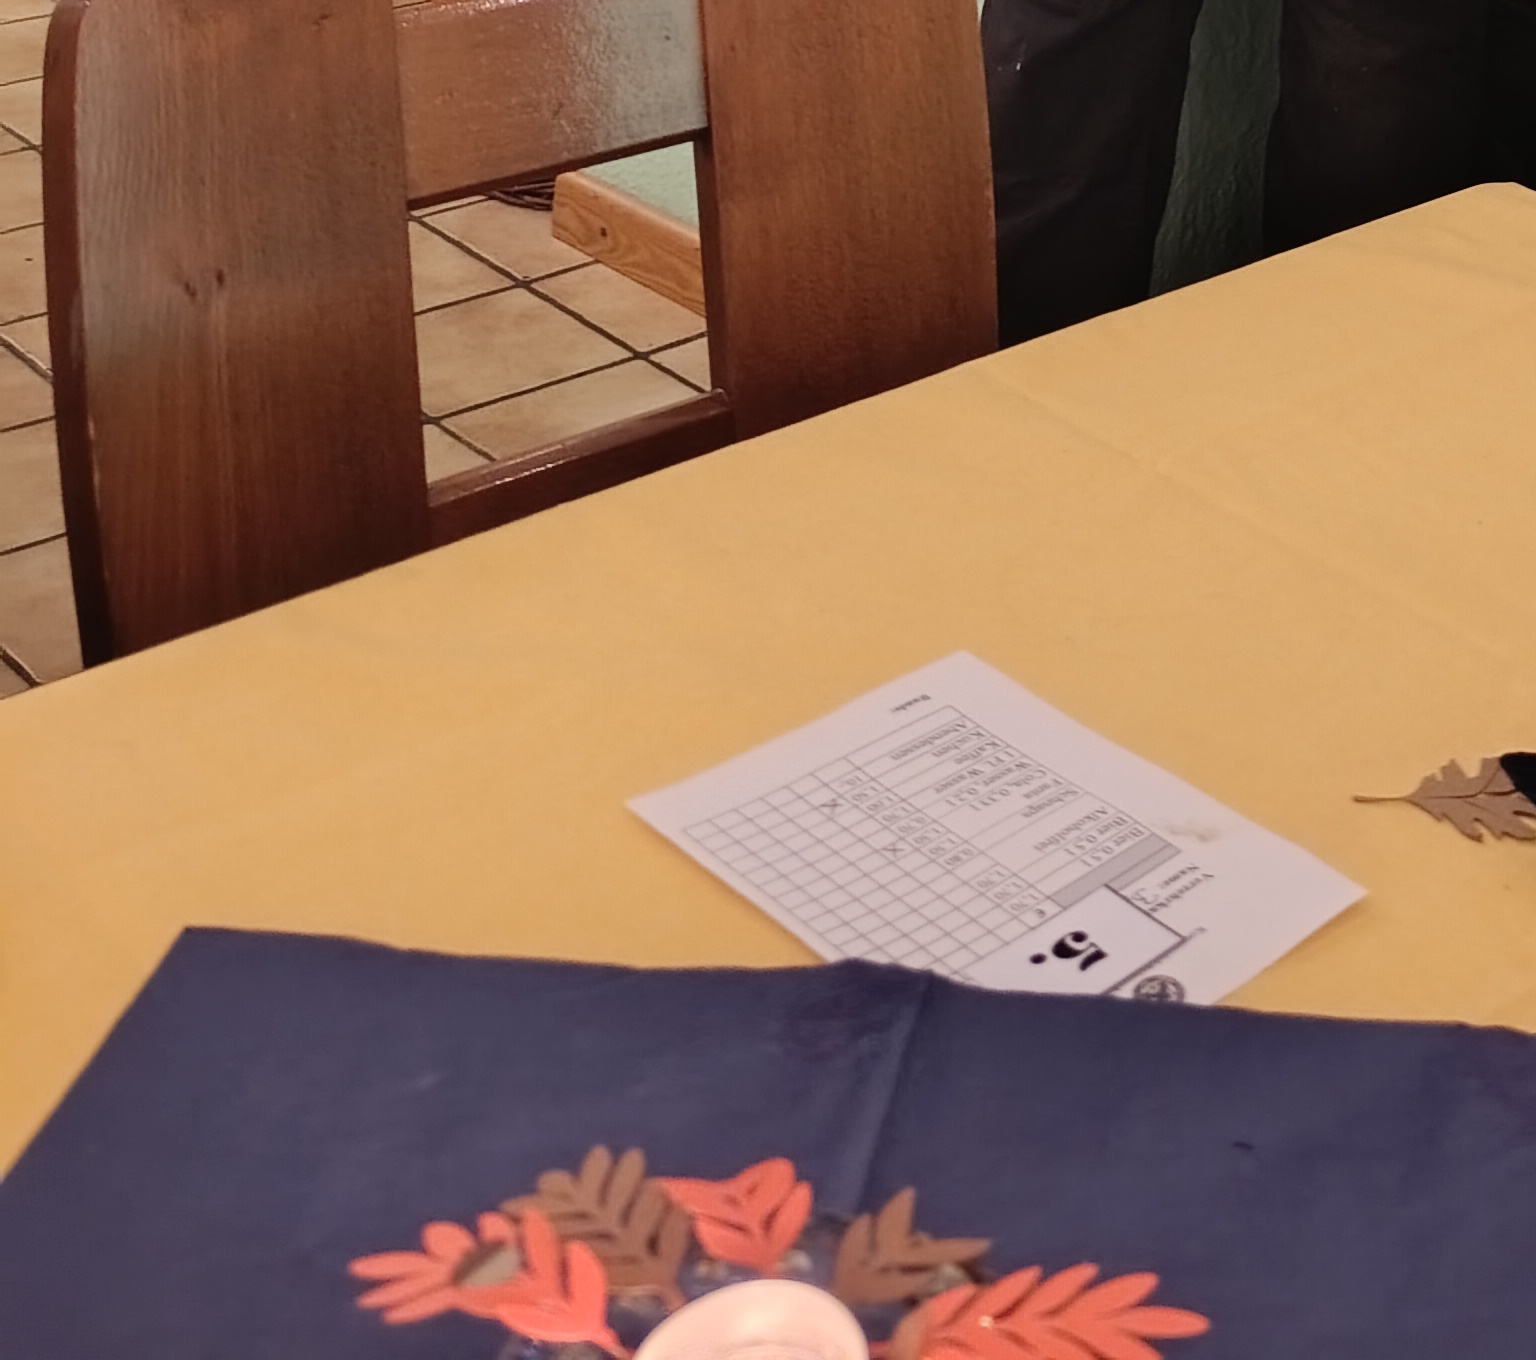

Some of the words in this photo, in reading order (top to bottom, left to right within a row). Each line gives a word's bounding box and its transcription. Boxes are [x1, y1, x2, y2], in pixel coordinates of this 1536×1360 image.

[890, 719, 967, 760] Abendessen
[930, 730, 986, 758] Kuchen
[954, 740, 1001, 765] Kaffee
[934, 768, 985, 794] Wasser
[1021, 779, 1063, 799] Fanta
[1021, 789, 1079, 818] Schnaps
[1034, 807, 1109, 853] Alkoholfrei
[1095, 816, 1128, 837] Bier
[1113, 827, 1144, 847] Bier
[1029, 931, 1109, 972] 5.
